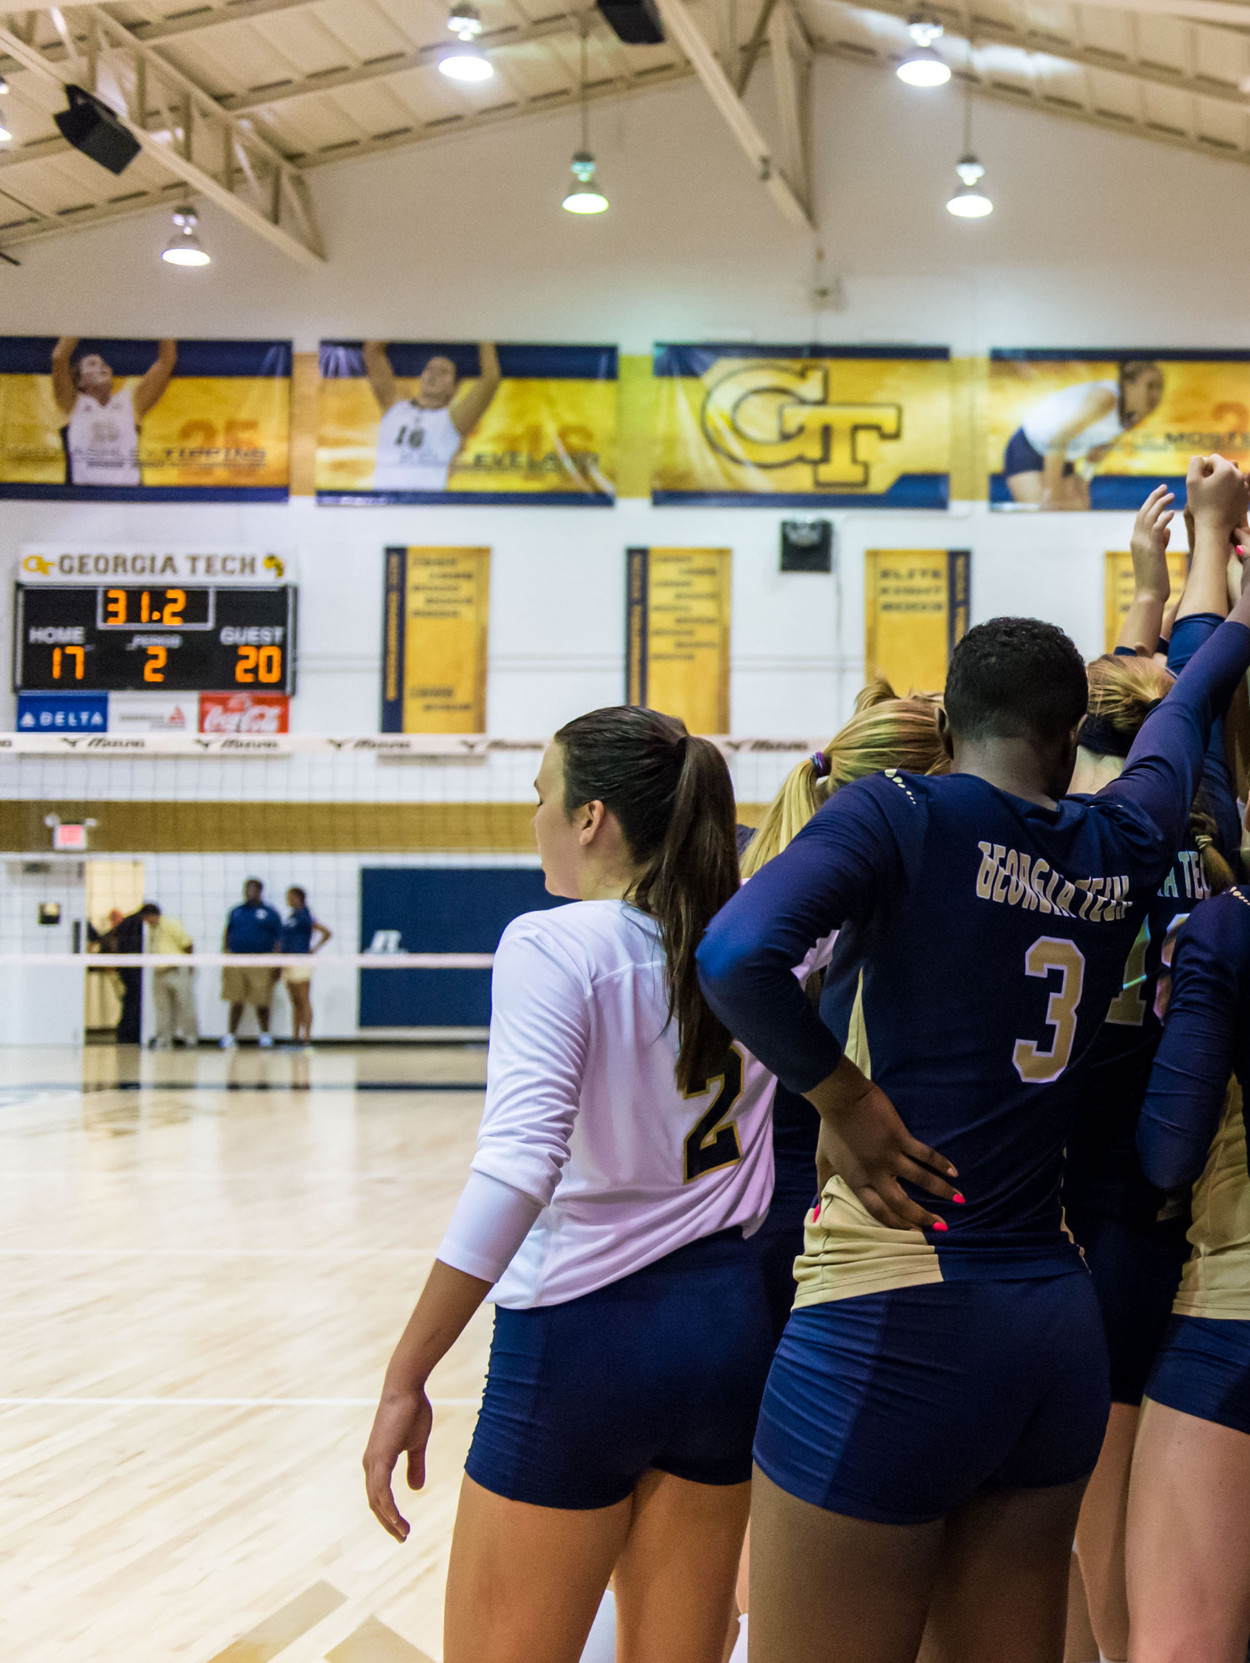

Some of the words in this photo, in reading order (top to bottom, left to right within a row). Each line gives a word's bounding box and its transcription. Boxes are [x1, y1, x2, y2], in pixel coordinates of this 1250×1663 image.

[58, 554, 178, 576] GEORGIA
[187, 554, 257, 576] TECH
[107, 588, 187, 625] 31.2
[29, 626, 86, 645] HOME
[220, 625, 284, 646] GUEST
[52, 645, 85, 680] 17
[144, 645, 168, 682] 2
[235, 645, 282, 683] 20
[40, 710, 104, 727] DELTA
[976, 841, 1077, 919] GEORGIA
[1012, 935, 1087, 1084] 3
[683, 1042, 745, 1185] 2
